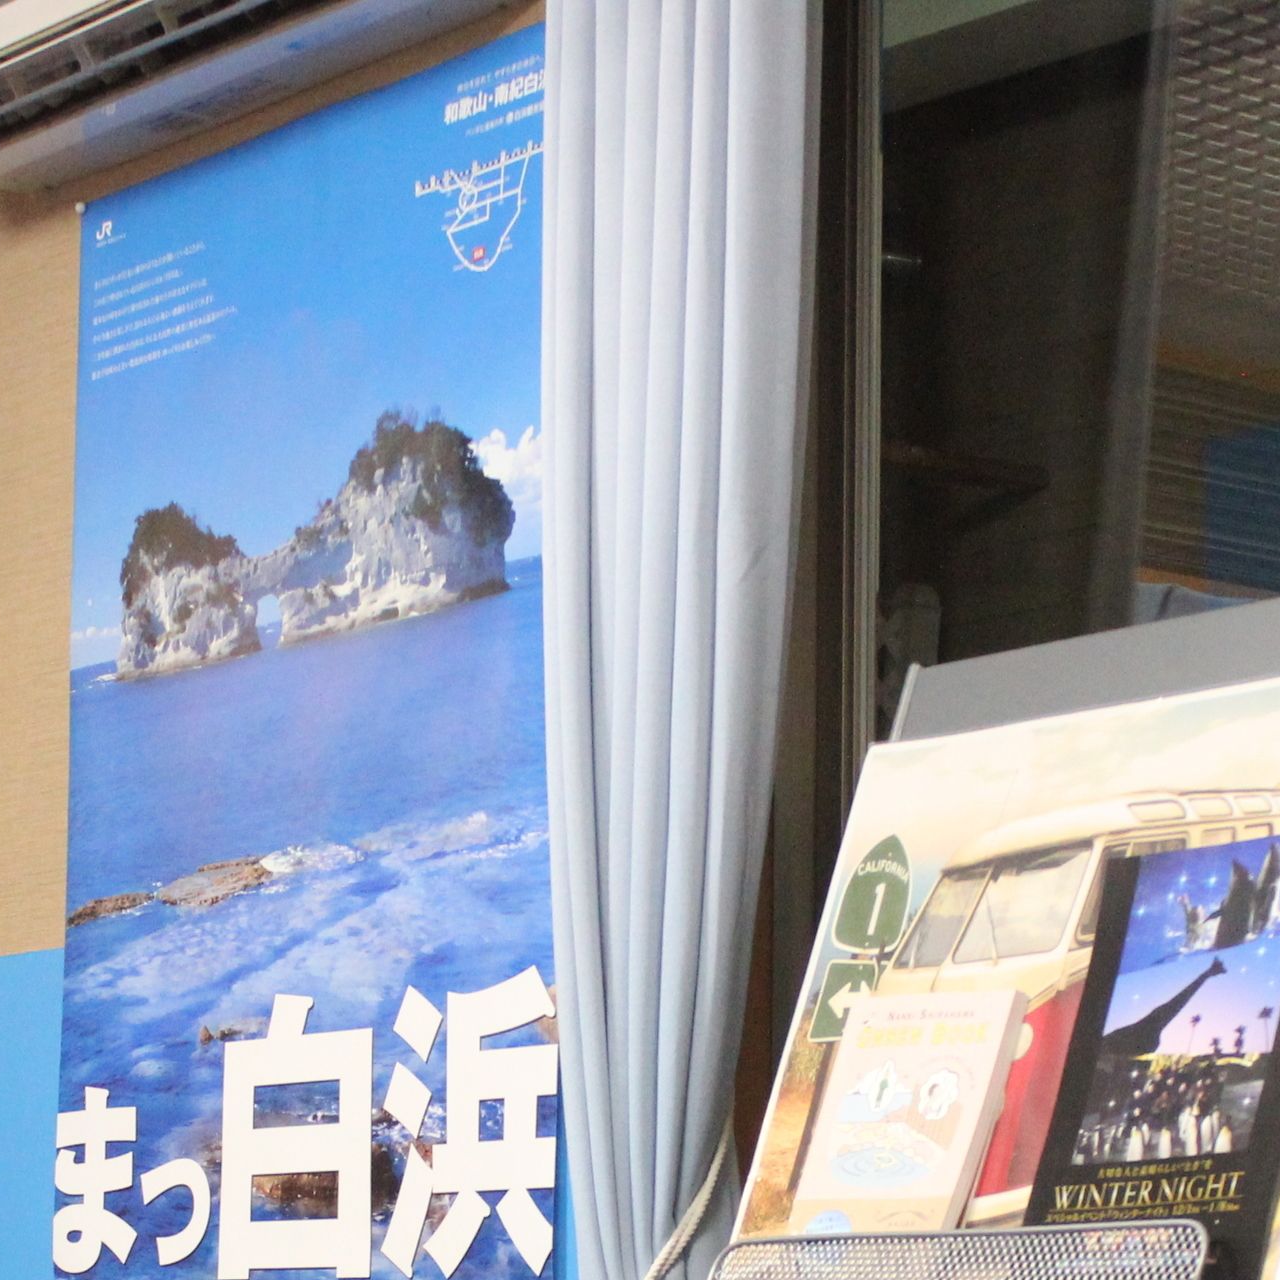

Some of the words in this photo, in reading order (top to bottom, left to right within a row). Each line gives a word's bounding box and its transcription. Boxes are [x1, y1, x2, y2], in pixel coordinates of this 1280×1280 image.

[95, 220, 113, 241] JR
[857, 859, 911, 884] CALIFORNIA
[866, 882, 887, 936] 1
[53, 966, 559, 1280] まっ白浜
[1053, 1180, 1152, 1210] WINTER
[1156, 1171, 1246, 1203] NIGHT
